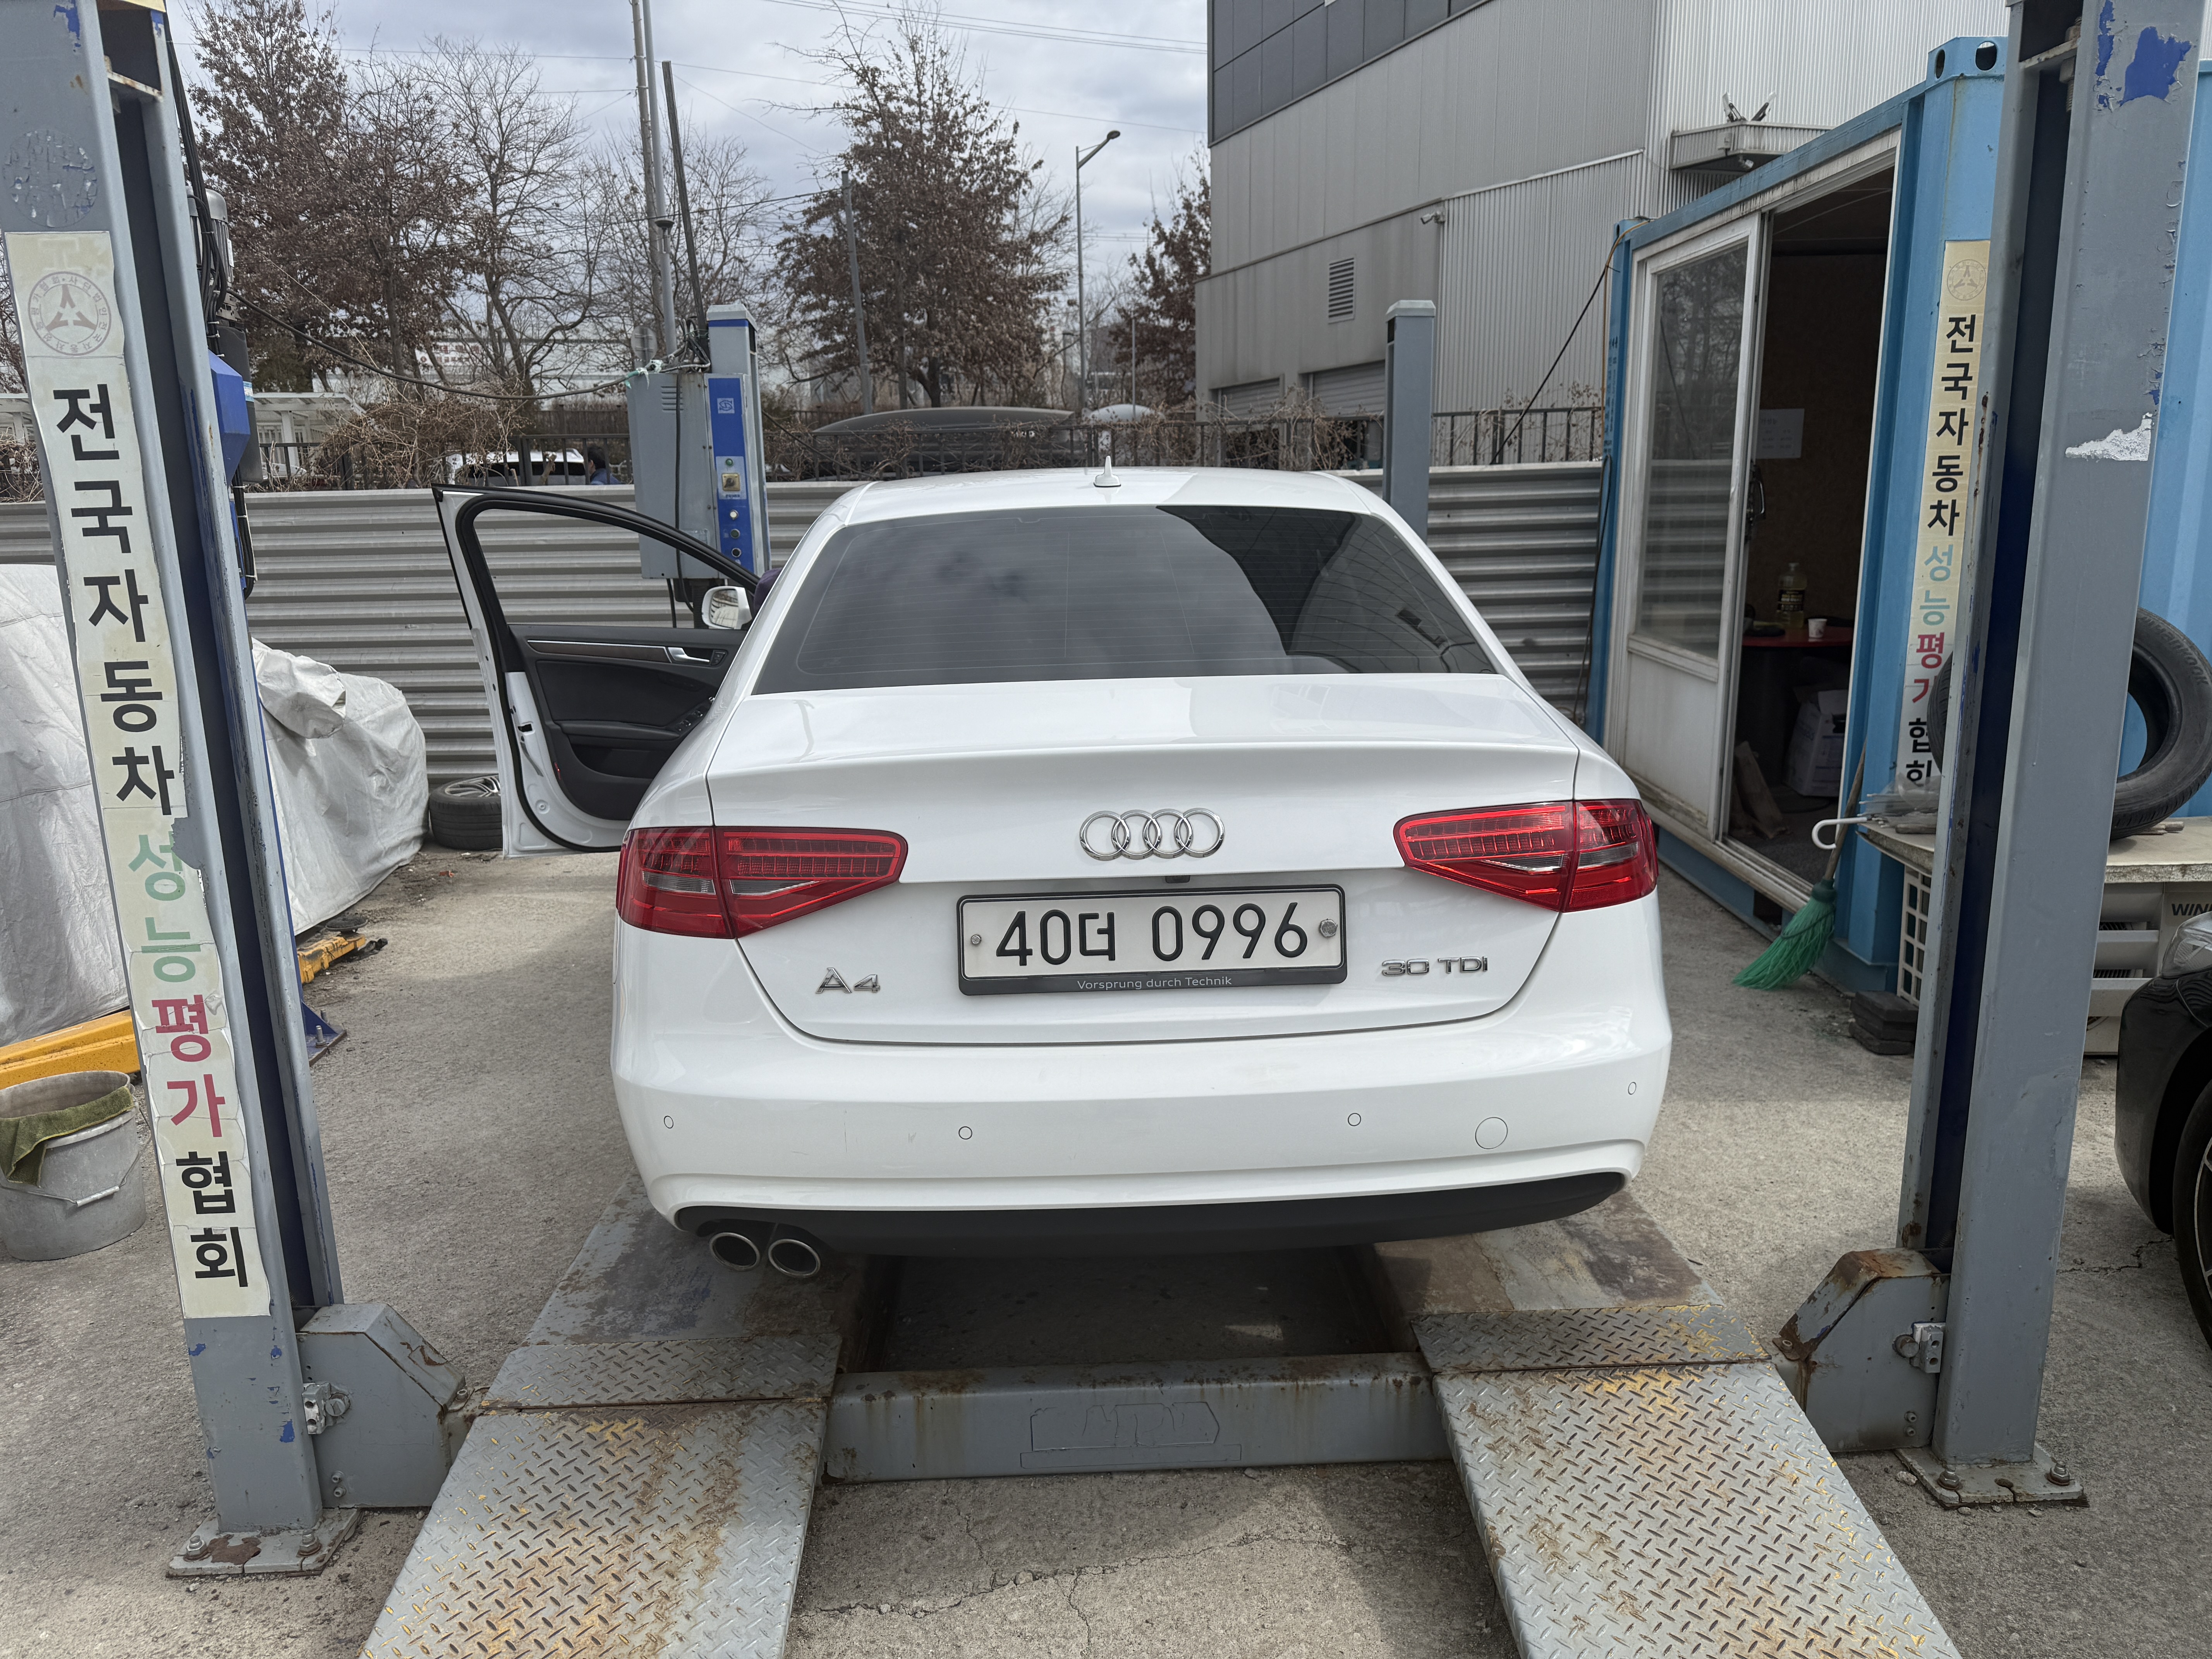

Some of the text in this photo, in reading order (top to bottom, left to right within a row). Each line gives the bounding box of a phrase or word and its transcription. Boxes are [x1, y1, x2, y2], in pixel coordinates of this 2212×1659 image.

[996, 902, 1308, 966] 40더 0996
[1381, 955, 1488, 976] 30 TDI
[815, 967, 881, 994] A4
[1077, 976, 1232, 991] Vorsprung durch Technik
